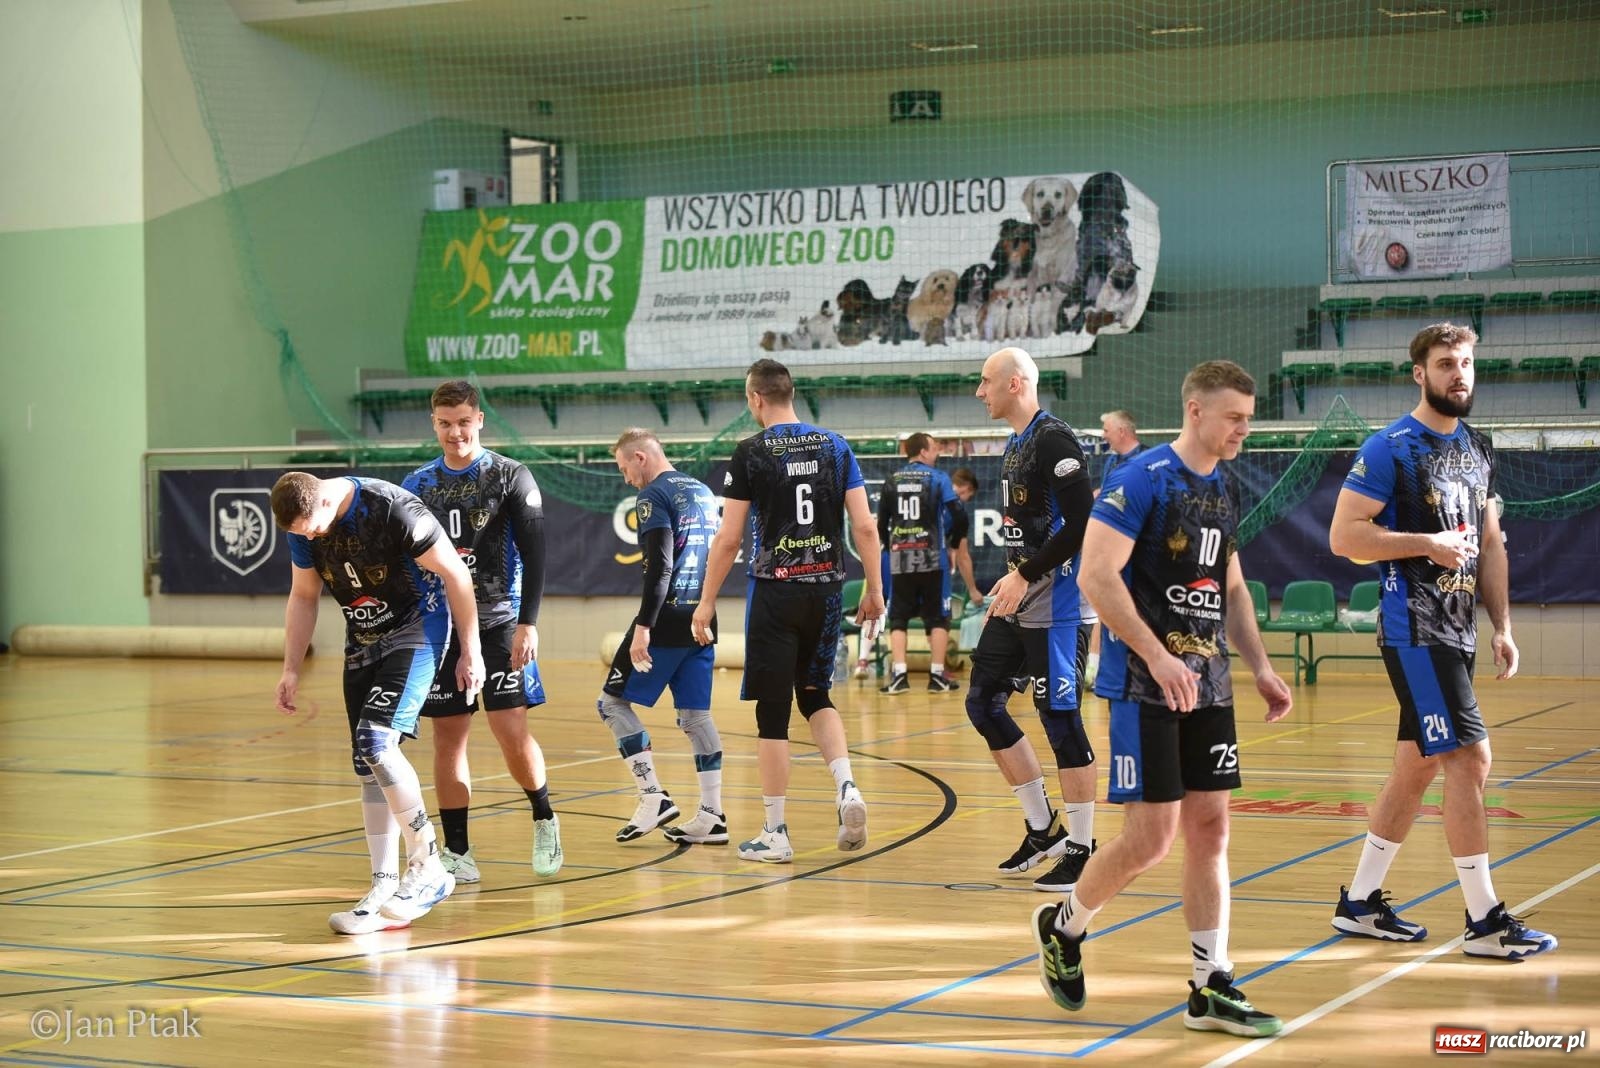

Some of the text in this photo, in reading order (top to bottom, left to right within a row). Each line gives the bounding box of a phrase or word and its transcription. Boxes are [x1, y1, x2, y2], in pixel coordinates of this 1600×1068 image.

[1365, 163, 1489, 193] MIESZKO
[662, 176, 1007, 232] WSZYSTKO DLA TWOJEGO
[506, 219, 623, 265] ZOO
[660, 225, 895, 273] DOMOWEGO ZOO
[493, 264, 615, 305] MAR
[489, 305, 612, 319] sklep zoologiczny
[703, 292, 720, 307] się
[696, 311, 712, 320] od
[426, 329, 603, 363] WWW.ZOO-MAR.PL
[764, 433, 829, 447] RESTAURACJA
[786, 460, 818, 477] WARDA
[795, 483, 814, 525] 6
[898, 495, 921, 521] 40
[1444, 481, 1470, 514] 24
[788, 535, 826, 549] bestfit
[815, 542, 832, 553] club
[1199, 527, 1221, 567] 10
[344, 561, 362, 588] 9
[1165, 585, 1222, 609] GOLD
[427, 692, 453, 700] ATOLIK
[1424, 714, 1448, 742] 24
[1114, 755, 1136, 790] 10
